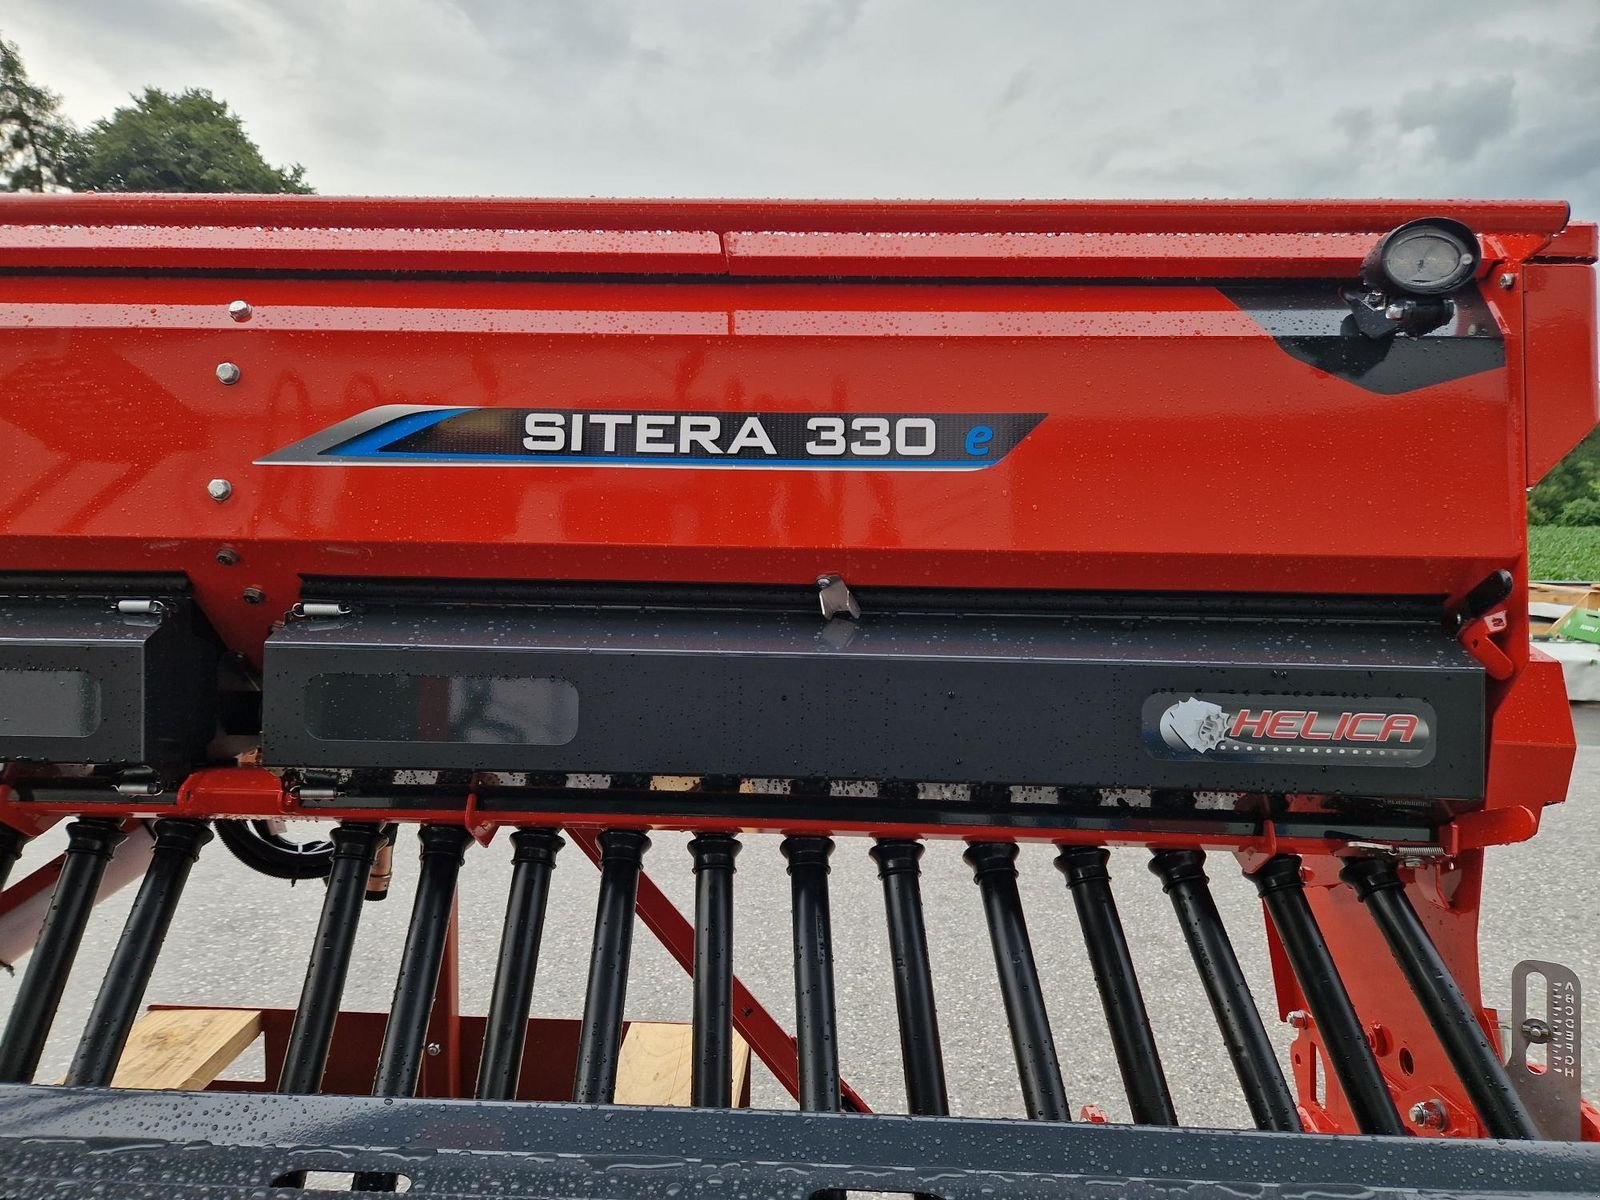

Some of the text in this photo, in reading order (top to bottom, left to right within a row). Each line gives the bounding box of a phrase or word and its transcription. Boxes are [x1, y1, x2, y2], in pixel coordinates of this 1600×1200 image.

[522, 413, 994, 457] SITERA 330 e
[1229, 709, 1420, 743] HELICA
